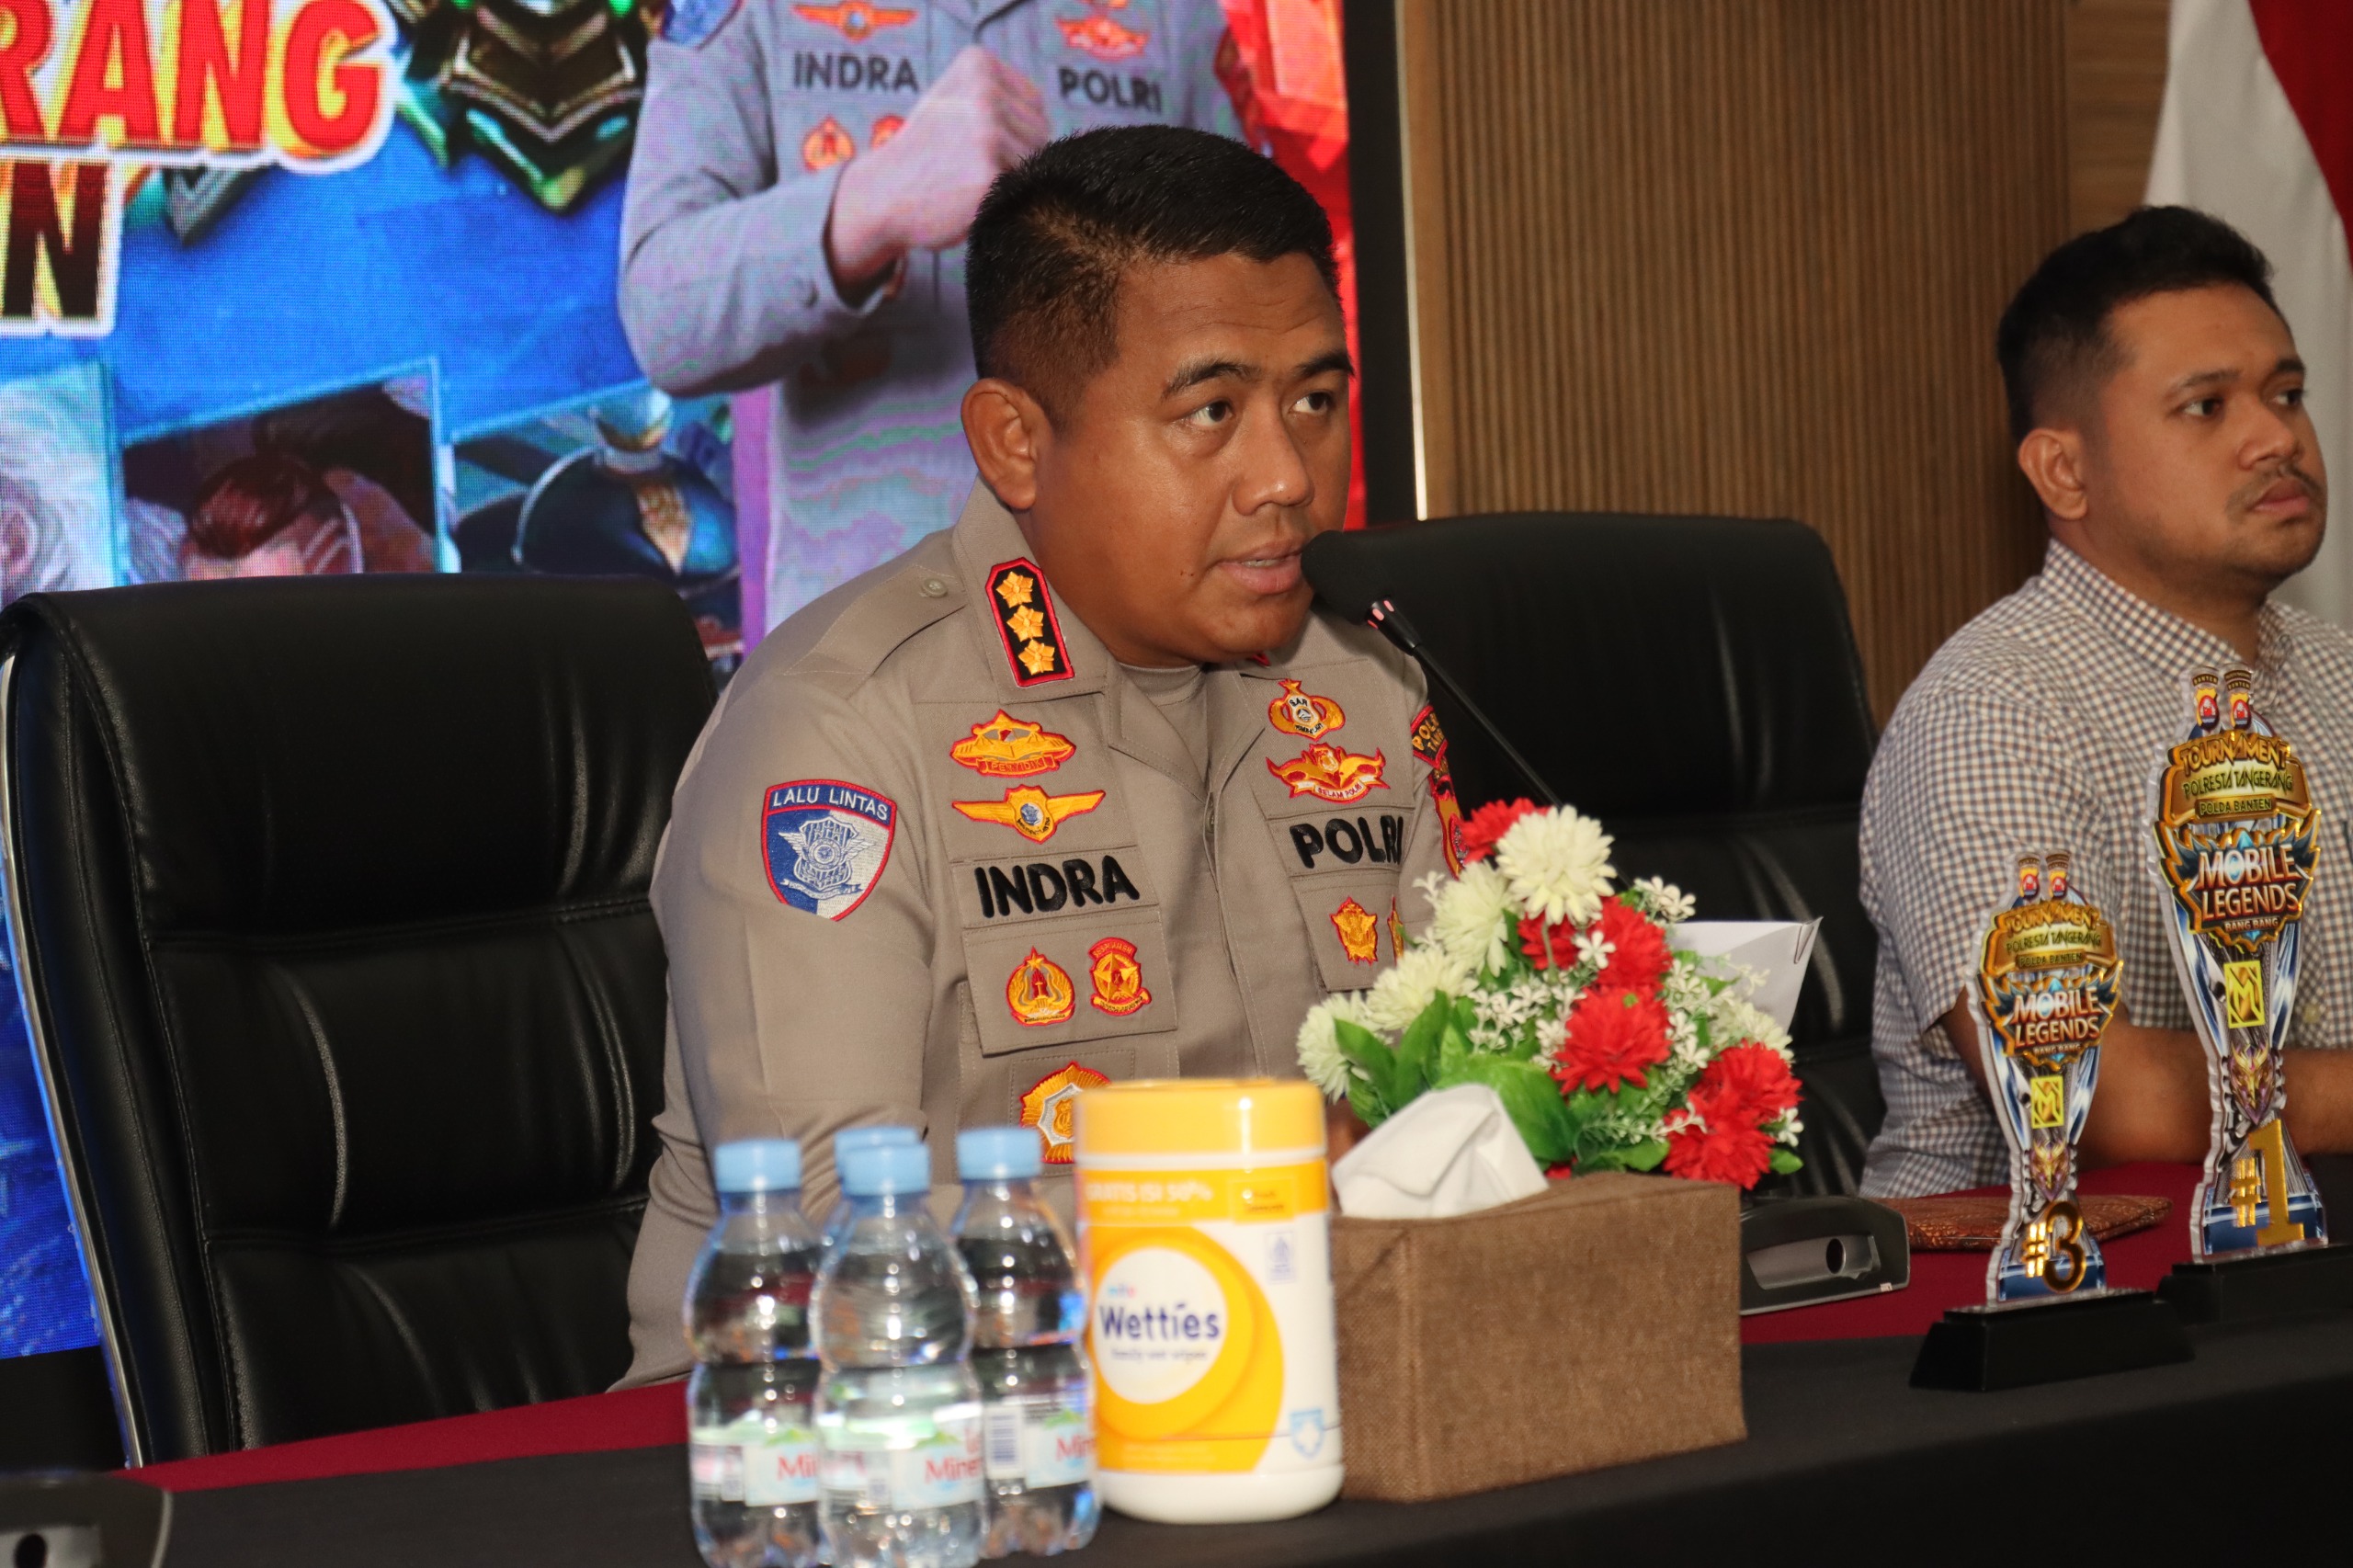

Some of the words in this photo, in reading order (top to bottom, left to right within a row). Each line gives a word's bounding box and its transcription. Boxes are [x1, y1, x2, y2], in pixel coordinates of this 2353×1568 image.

[793, 51, 918, 90] INDRA
[1057, 67, 1162, 114] POLRI
[1290, 698, 1307, 707] SAR
[2180, 734, 2288, 777] TOURNAMENT
[2183, 767, 2233, 799] POLRESTA
[2234, 766, 2293, 795] TANGERANG
[773, 788, 820, 807] LALU
[829, 789, 888, 821] LINTAS
[2200, 801, 2231, 815] POLDA
[2234, 798, 2271, 813] BANTEN
[1290, 814, 1404, 869] POLRI
[2196, 843, 2302, 889] MOBILE
[974, 855, 1141, 918] INDRA
[2202, 883, 2299, 920] LEGENDS
[2224, 920, 2251, 932] BANG
[2252, 917, 2279, 930] BANG
[2012, 985, 2103, 1024] MOBILE
[2015, 1017, 2100, 1048] LEGENDS
[2230, 1119, 2305, 1246] #1
[2021, 1200, 2086, 1294] #3
